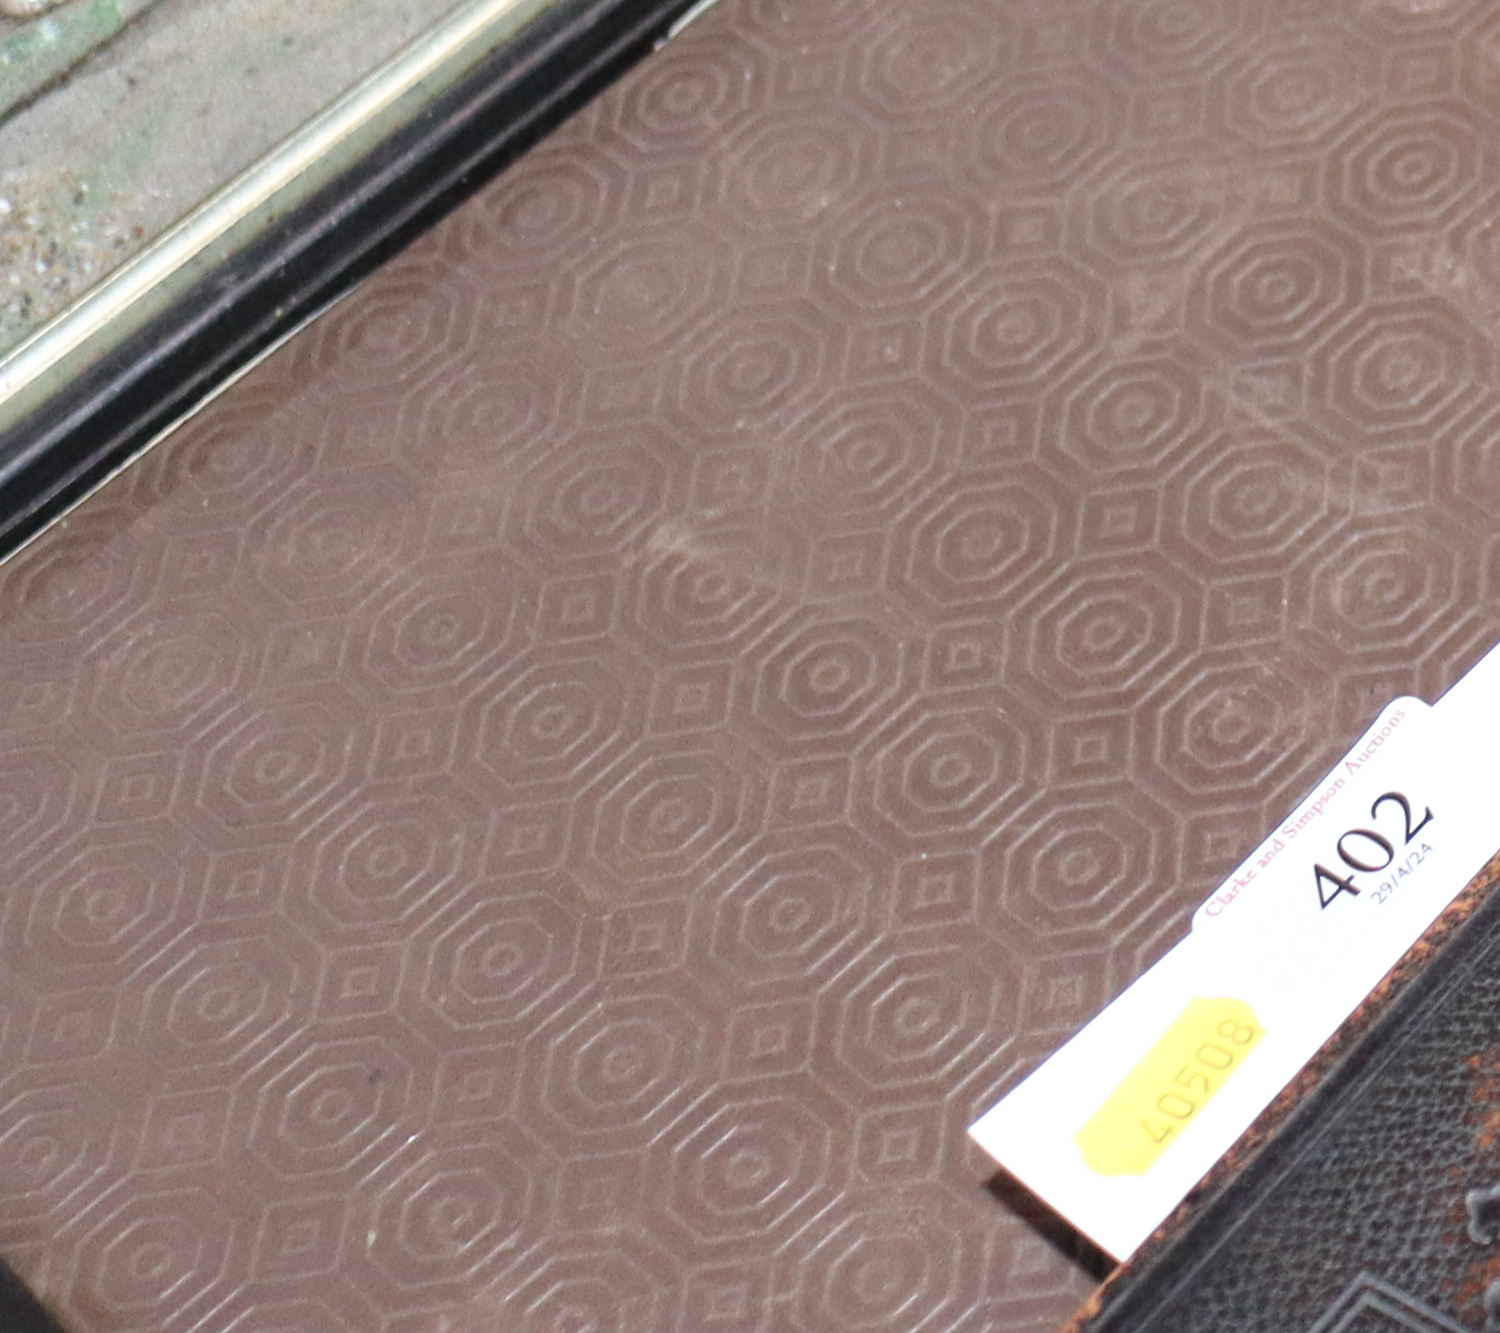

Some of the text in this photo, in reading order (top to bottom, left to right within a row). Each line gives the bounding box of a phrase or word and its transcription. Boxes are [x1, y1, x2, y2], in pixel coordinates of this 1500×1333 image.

[1205, 708, 1406, 916] Clarke and Simpson Auctions
[1313, 791, 1435, 911] 402
[1370, 841, 1434, 905] 29/4/24
[1140, 1018, 1255, 1145] 40508
